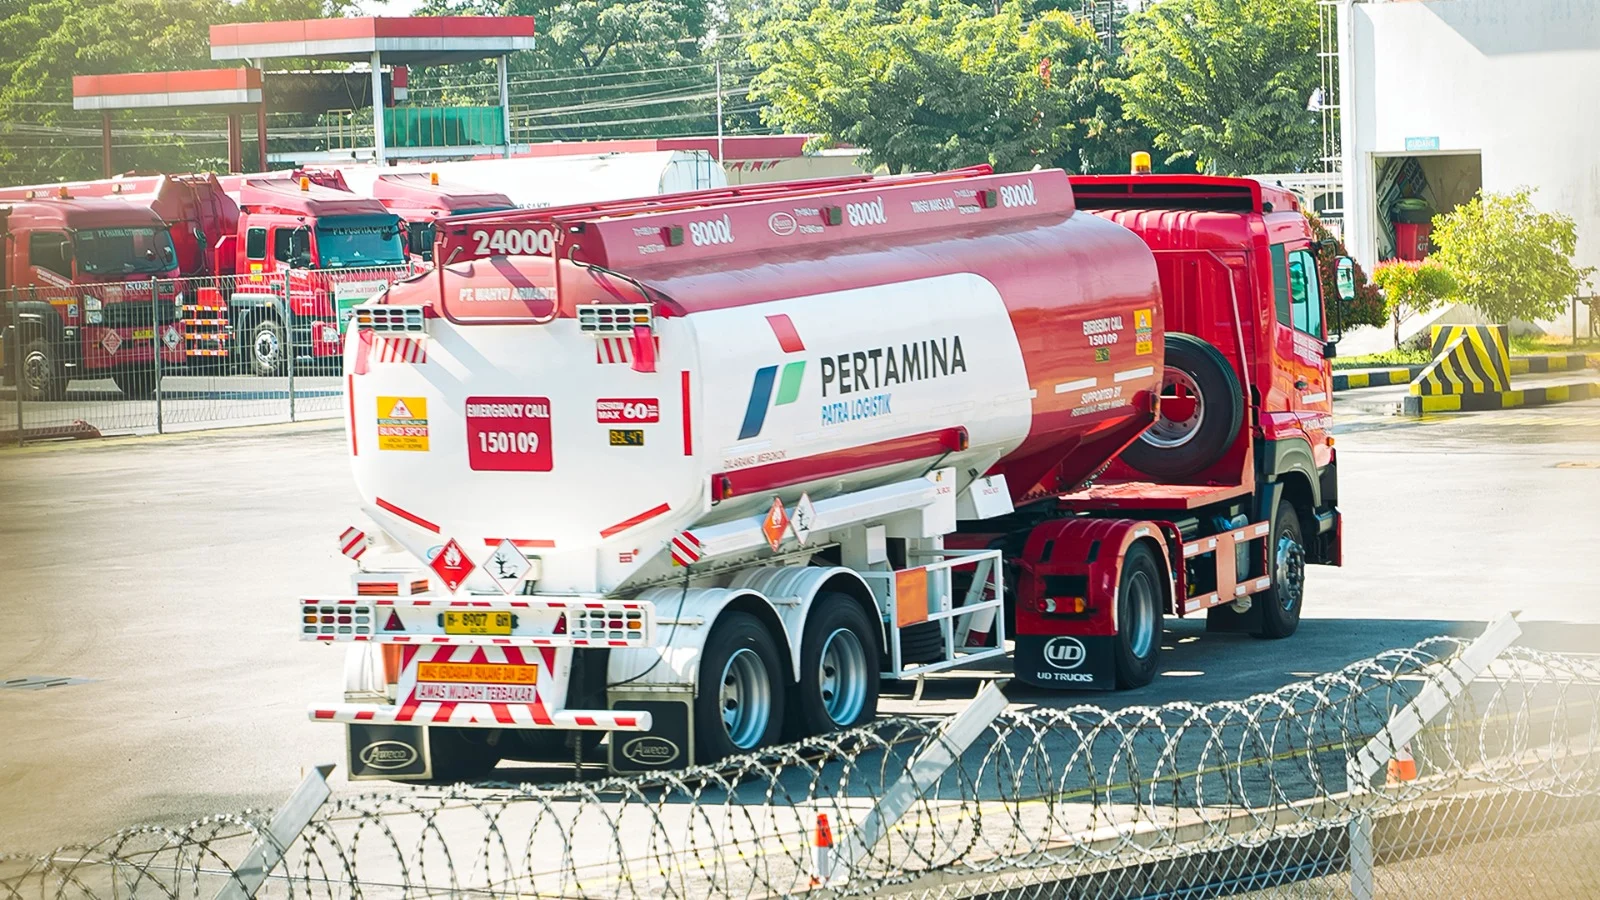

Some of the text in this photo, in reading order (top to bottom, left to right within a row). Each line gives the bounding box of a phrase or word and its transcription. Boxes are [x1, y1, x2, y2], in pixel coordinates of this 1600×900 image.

[472, 229, 554, 255] 24000
[1083, 316, 1123, 335] EMERGENCY CALL
[1089, 333, 1118, 346] 150109
[820, 335, 967, 398] PERTAMINA
[467, 404, 549, 418] EMERGENCY CALL
[598, 402, 648, 419] MAX 60
[821, 393, 892, 427] PATRA LOGISTIK
[379, 427, 428, 436] BLIND SPOT
[478, 432, 539, 453] 150109
[723, 450, 788, 468] DILARANG MEROKOK
[449, 581, 457, 589] 3
[1048, 645, 1082, 660] UD
[1037, 672, 1093, 682] UD TRUCKS
[420, 685, 532, 700] AWAS MUDAH TERBAKAR
